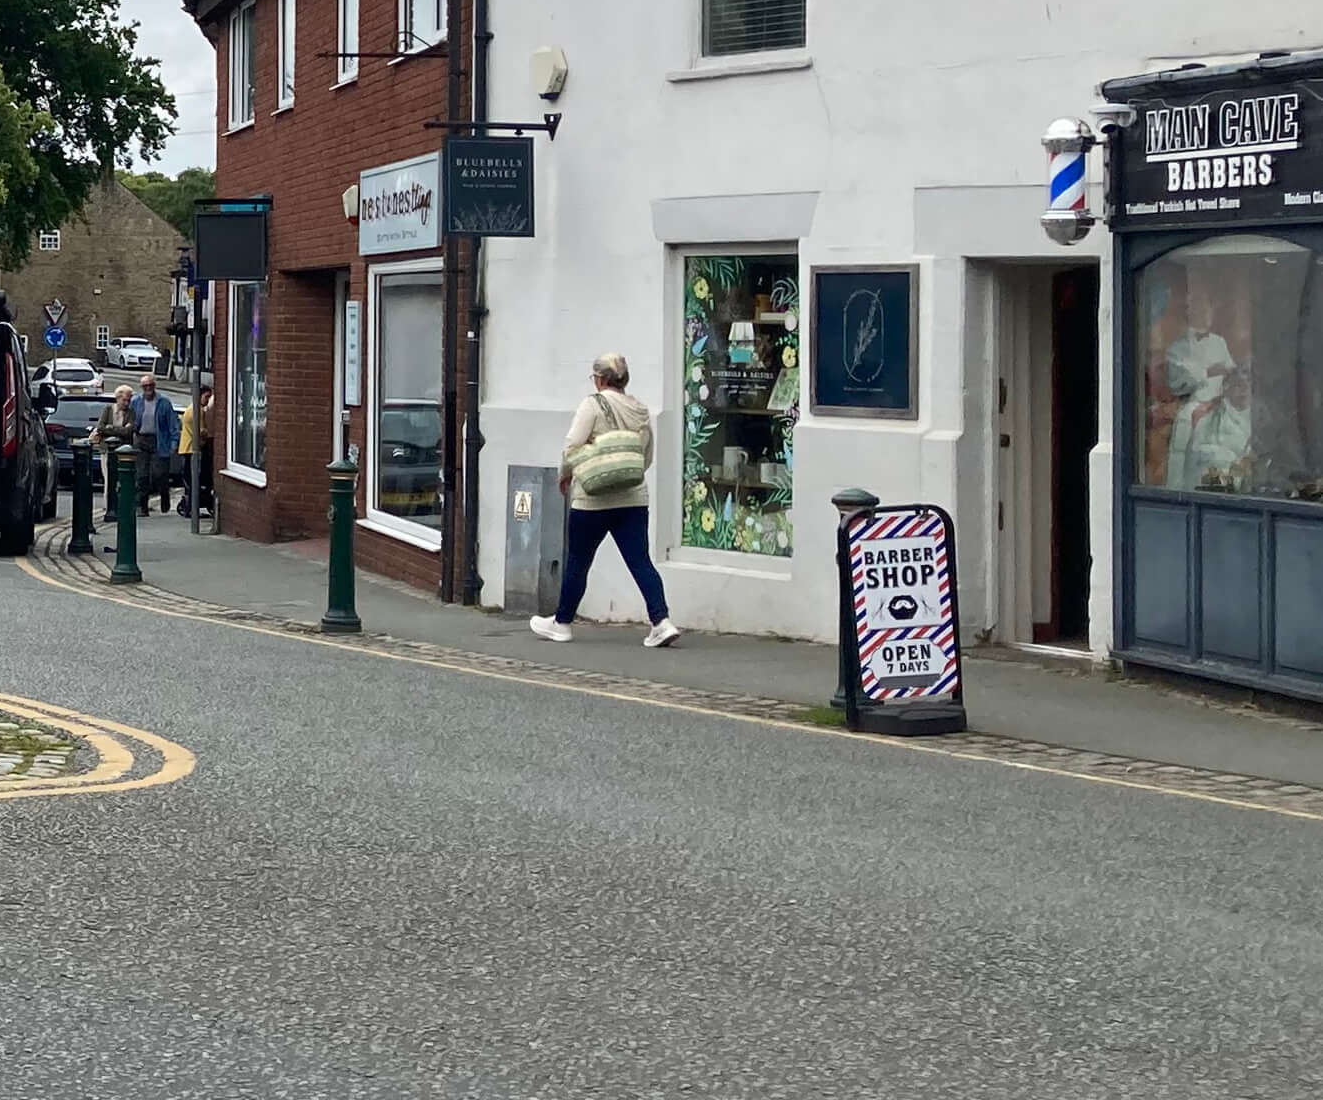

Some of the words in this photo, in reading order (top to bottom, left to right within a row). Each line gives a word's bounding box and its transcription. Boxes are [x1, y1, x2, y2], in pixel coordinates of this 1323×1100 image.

[1145, 104, 1210, 154] MAN
[1219, 93, 1299, 147] CAVE
[456, 158, 523, 168] BLUEBELLS
[1167, 153, 1272, 192] BARBERS
[863, 547, 934, 565] BARBER
[865, 564, 935, 589] SHOP
[882, 644, 931, 662] OPEN
[887, 663, 893, 674] 7
[899, 660, 930, 673] DAYS
